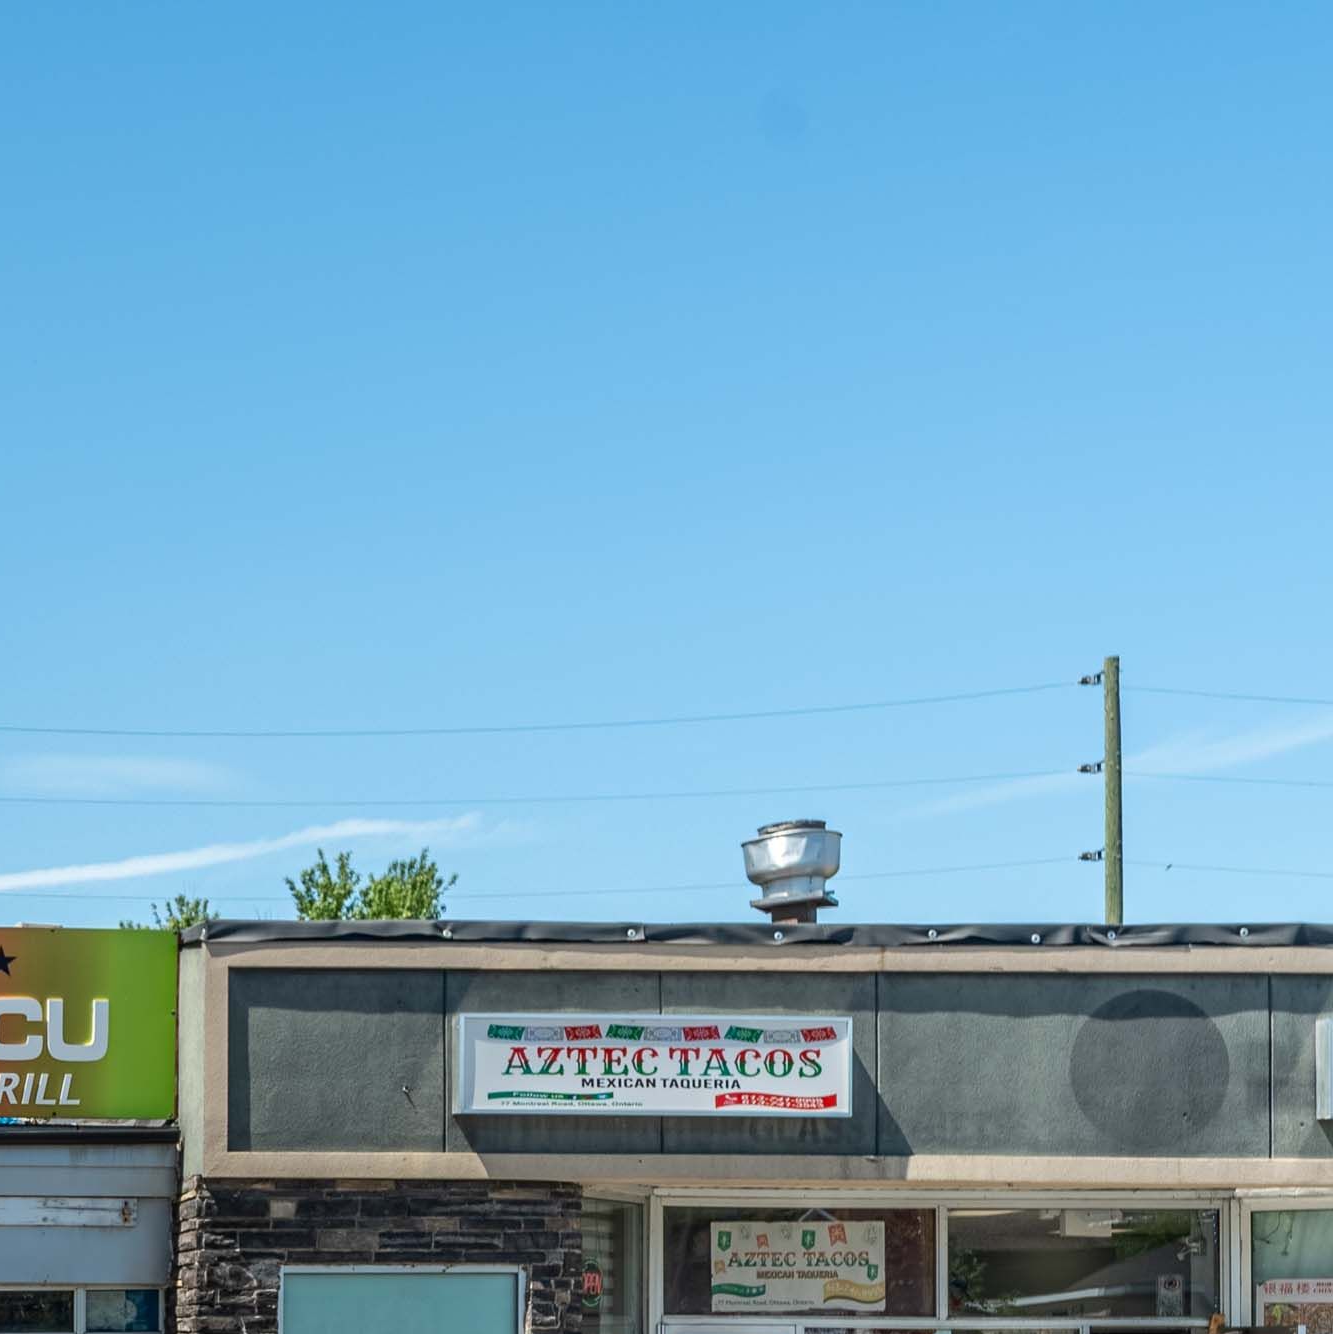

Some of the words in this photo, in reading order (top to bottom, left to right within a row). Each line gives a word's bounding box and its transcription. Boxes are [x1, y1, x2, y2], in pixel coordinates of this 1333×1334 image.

[501, 1046, 659, 1076] AZTEC
[669, 1047, 822, 1078] TACOS
[581, 1077, 657, 1089] MEXICAN
[661, 1078, 741, 1090] TAQUERIA
[727, 1251, 797, 1268] AZTEC
[803, 1251, 870, 1268] TACOS
